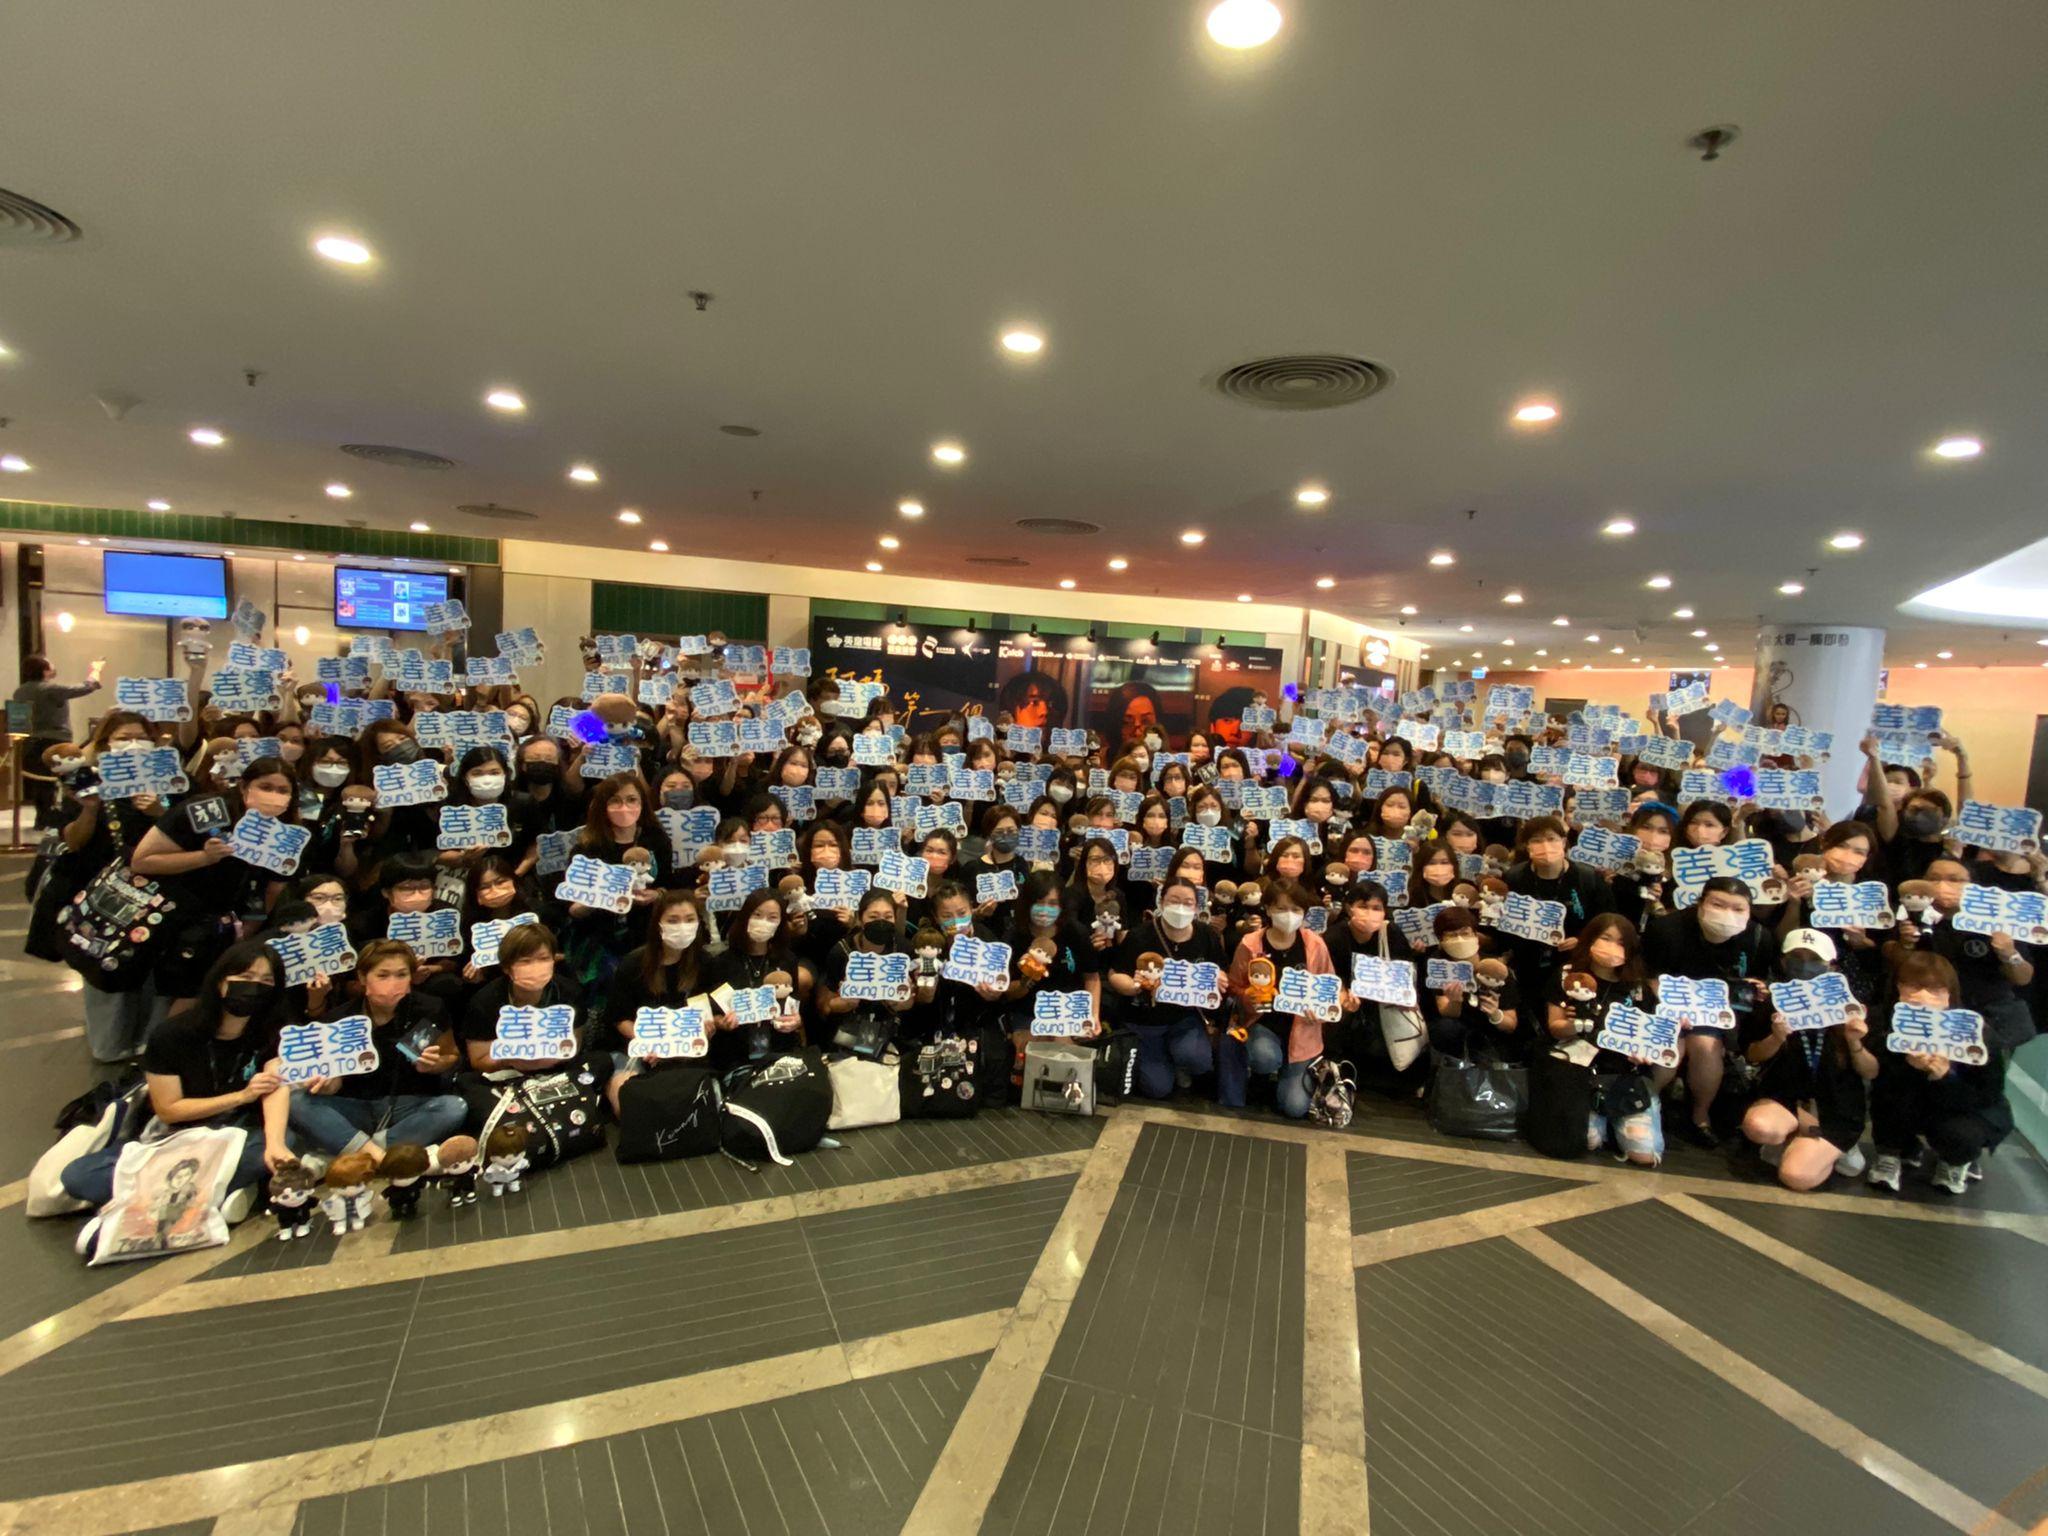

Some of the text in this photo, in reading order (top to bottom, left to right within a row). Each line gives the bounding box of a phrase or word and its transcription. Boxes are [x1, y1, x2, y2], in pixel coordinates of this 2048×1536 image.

[101, 781, 170, 797] Keung To
[378, 788, 432, 807] Keung To
[438, 834, 497, 847] Keung To
[1951, 828, 2018, 849] Keung To
[262, 853, 282, 868] To
[1570, 849, 1621, 871] Keung To
[874, 872, 917, 894] Keung To
[556, 884, 617, 909] Keung To
[707, 896, 742, 910] Keung
[844, 897, 859, 909] To
[1500, 916, 1548, 940] Keung To
[1813, 914, 1876, 927] Keung To
[2010, 923, 2030, 937] To
[430, 941, 447, 953] To
[320, 960, 339, 973] To
[944, 965, 995, 985] Keung To
[841, 985, 895, 999] Keung To
[1156, 989, 1206, 1004] Keung To
[1312, 1005, 1326, 1016] To
[1702, 1010, 1718, 1024] To
[1787, 1009, 1843, 1027] eung To
[1032, 1021, 1080, 1034] Keung To
[492, 1042, 559, 1058] Keung To
[630, 1040, 689, 1056] Keung To
[1599, 1033, 1661, 1058] Keung To
[1888, 1036, 1965, 1059] Keung To
[337, 1060, 356, 1072] To
